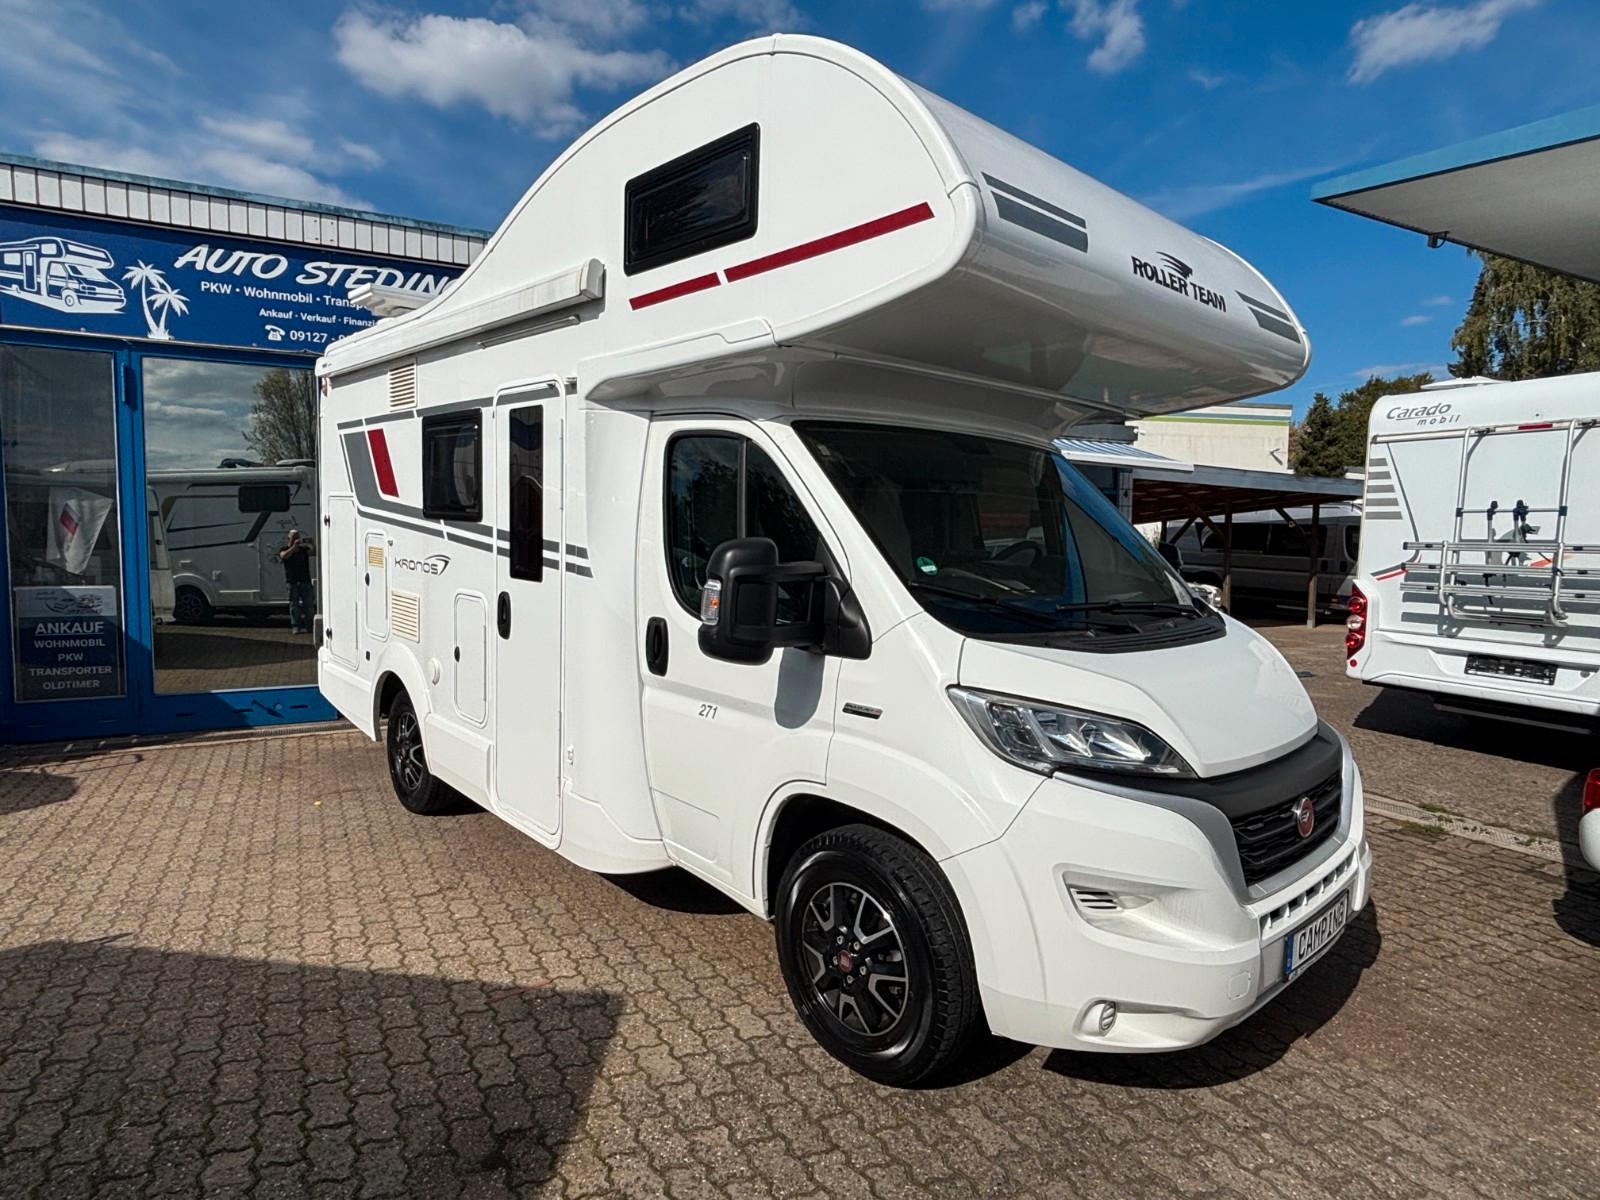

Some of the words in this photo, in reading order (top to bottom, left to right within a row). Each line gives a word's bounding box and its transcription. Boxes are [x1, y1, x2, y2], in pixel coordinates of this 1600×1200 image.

[173, 243, 288, 279] AUTO
[1130, 255, 1190, 297] ROLLER
[1190, 281, 1227, 313] TEAM
[201, 281, 232, 295] PKW
[243, 286, 313, 304] Wohnmobil
[322, 295, 369, 311] Transp
[259, 308, 293, 320] Ankauf
[300, 312, 336, 323] Verkauf
[343, 316, 378, 328] Finanzi
[289, 330, 328, 343] 09127
[1386, 403, 1452, 420] Carado
[1417, 414, 1461, 426] mobil
[34, 621, 105, 635] ANKAUF
[33, 638, 106, 649] WOHNMOBIL
[57, 652, 84, 662] PKW
[29, 665, 112, 677] TRANSPORTER
[42, 679, 101, 690] OLDTIMER
[698, 703, 718, 720] 271
[1298, 900, 1345, 960] CAMPING
